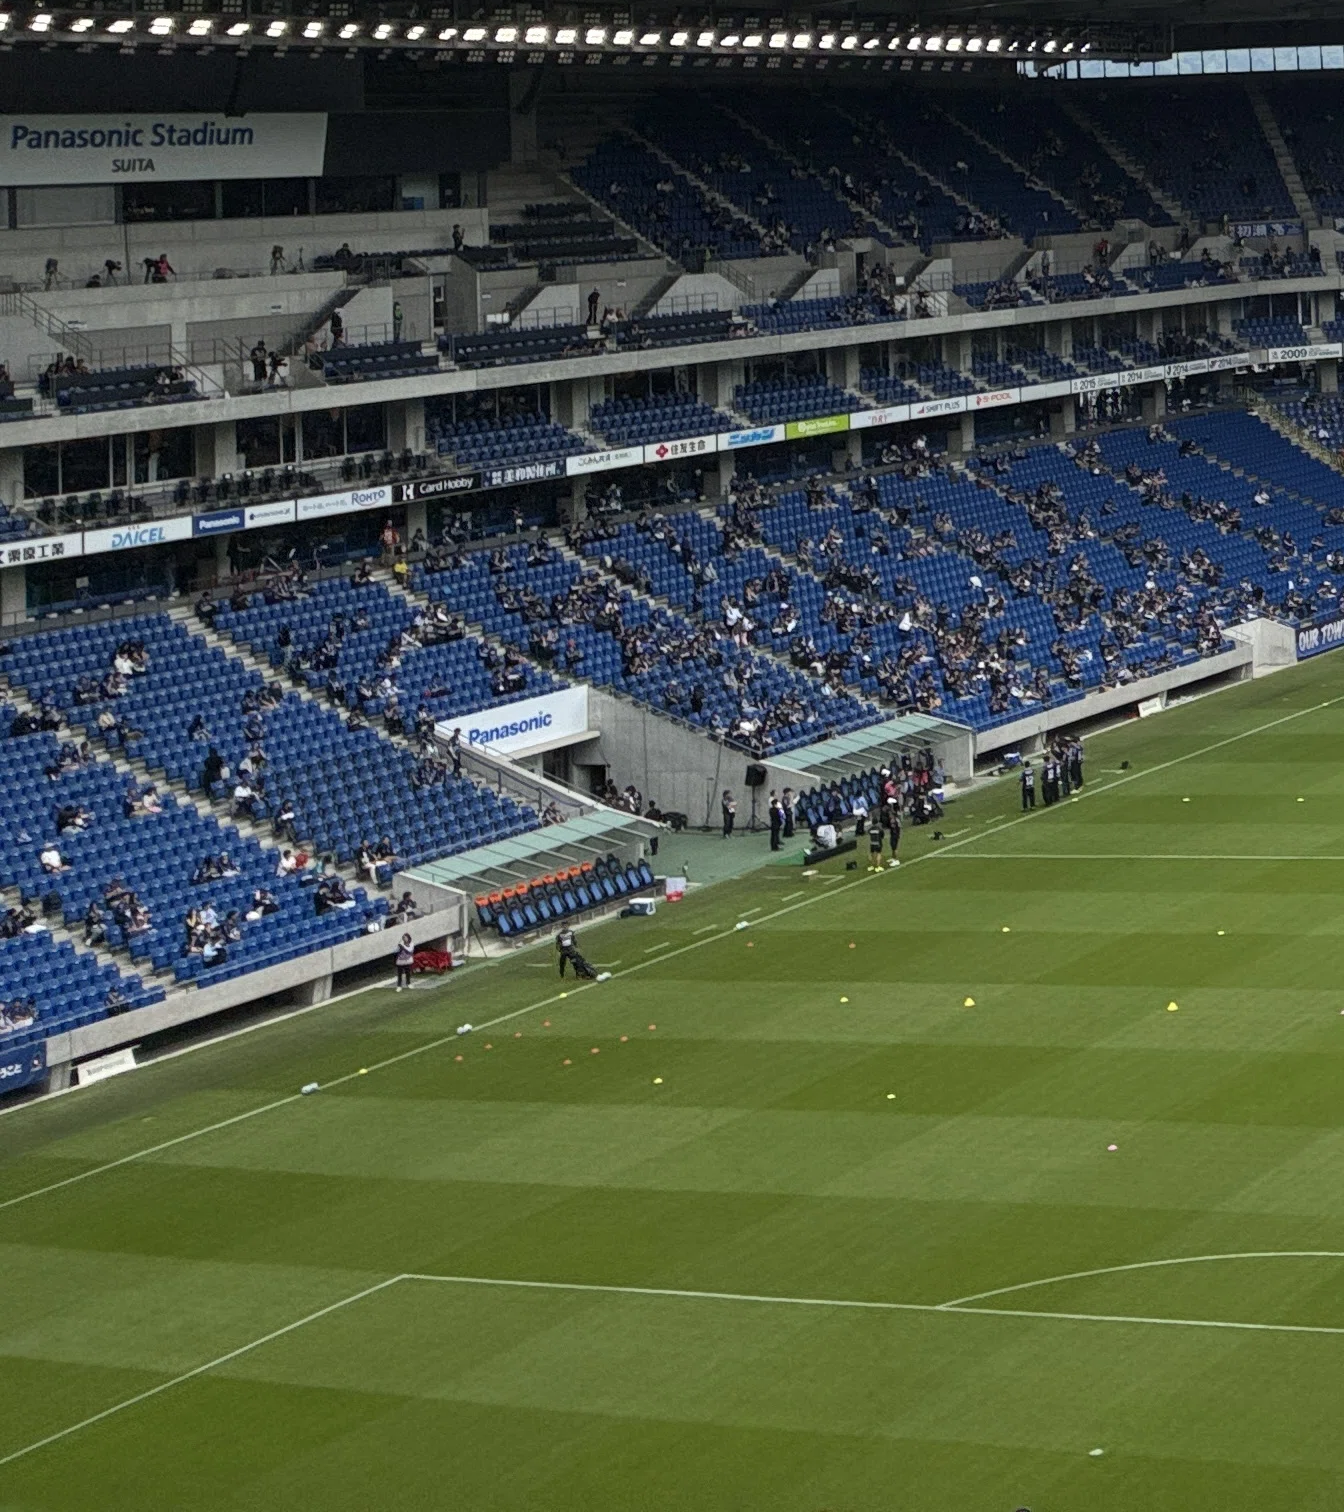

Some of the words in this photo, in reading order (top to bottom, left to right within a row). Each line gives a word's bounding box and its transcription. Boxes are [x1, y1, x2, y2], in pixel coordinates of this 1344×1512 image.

[11, 122, 144, 150] Panasonic
[150, 121, 254, 147] Stadium
[111, 157, 156, 174] SUITA
[1280, 348, 1307, 360] 2009
[1127, 371, 1143, 383] 2014
[670, 439, 706, 456] 住友生命
[419, 479, 443, 495] Card
[443, 476, 474, 492] Hobby
[198, 515, 241, 530] Panasonic
[112, 526, 166, 549] DAICEL
[1299, 626, 1319, 649] OUR
[469, 710, 553, 745] Panasonic
